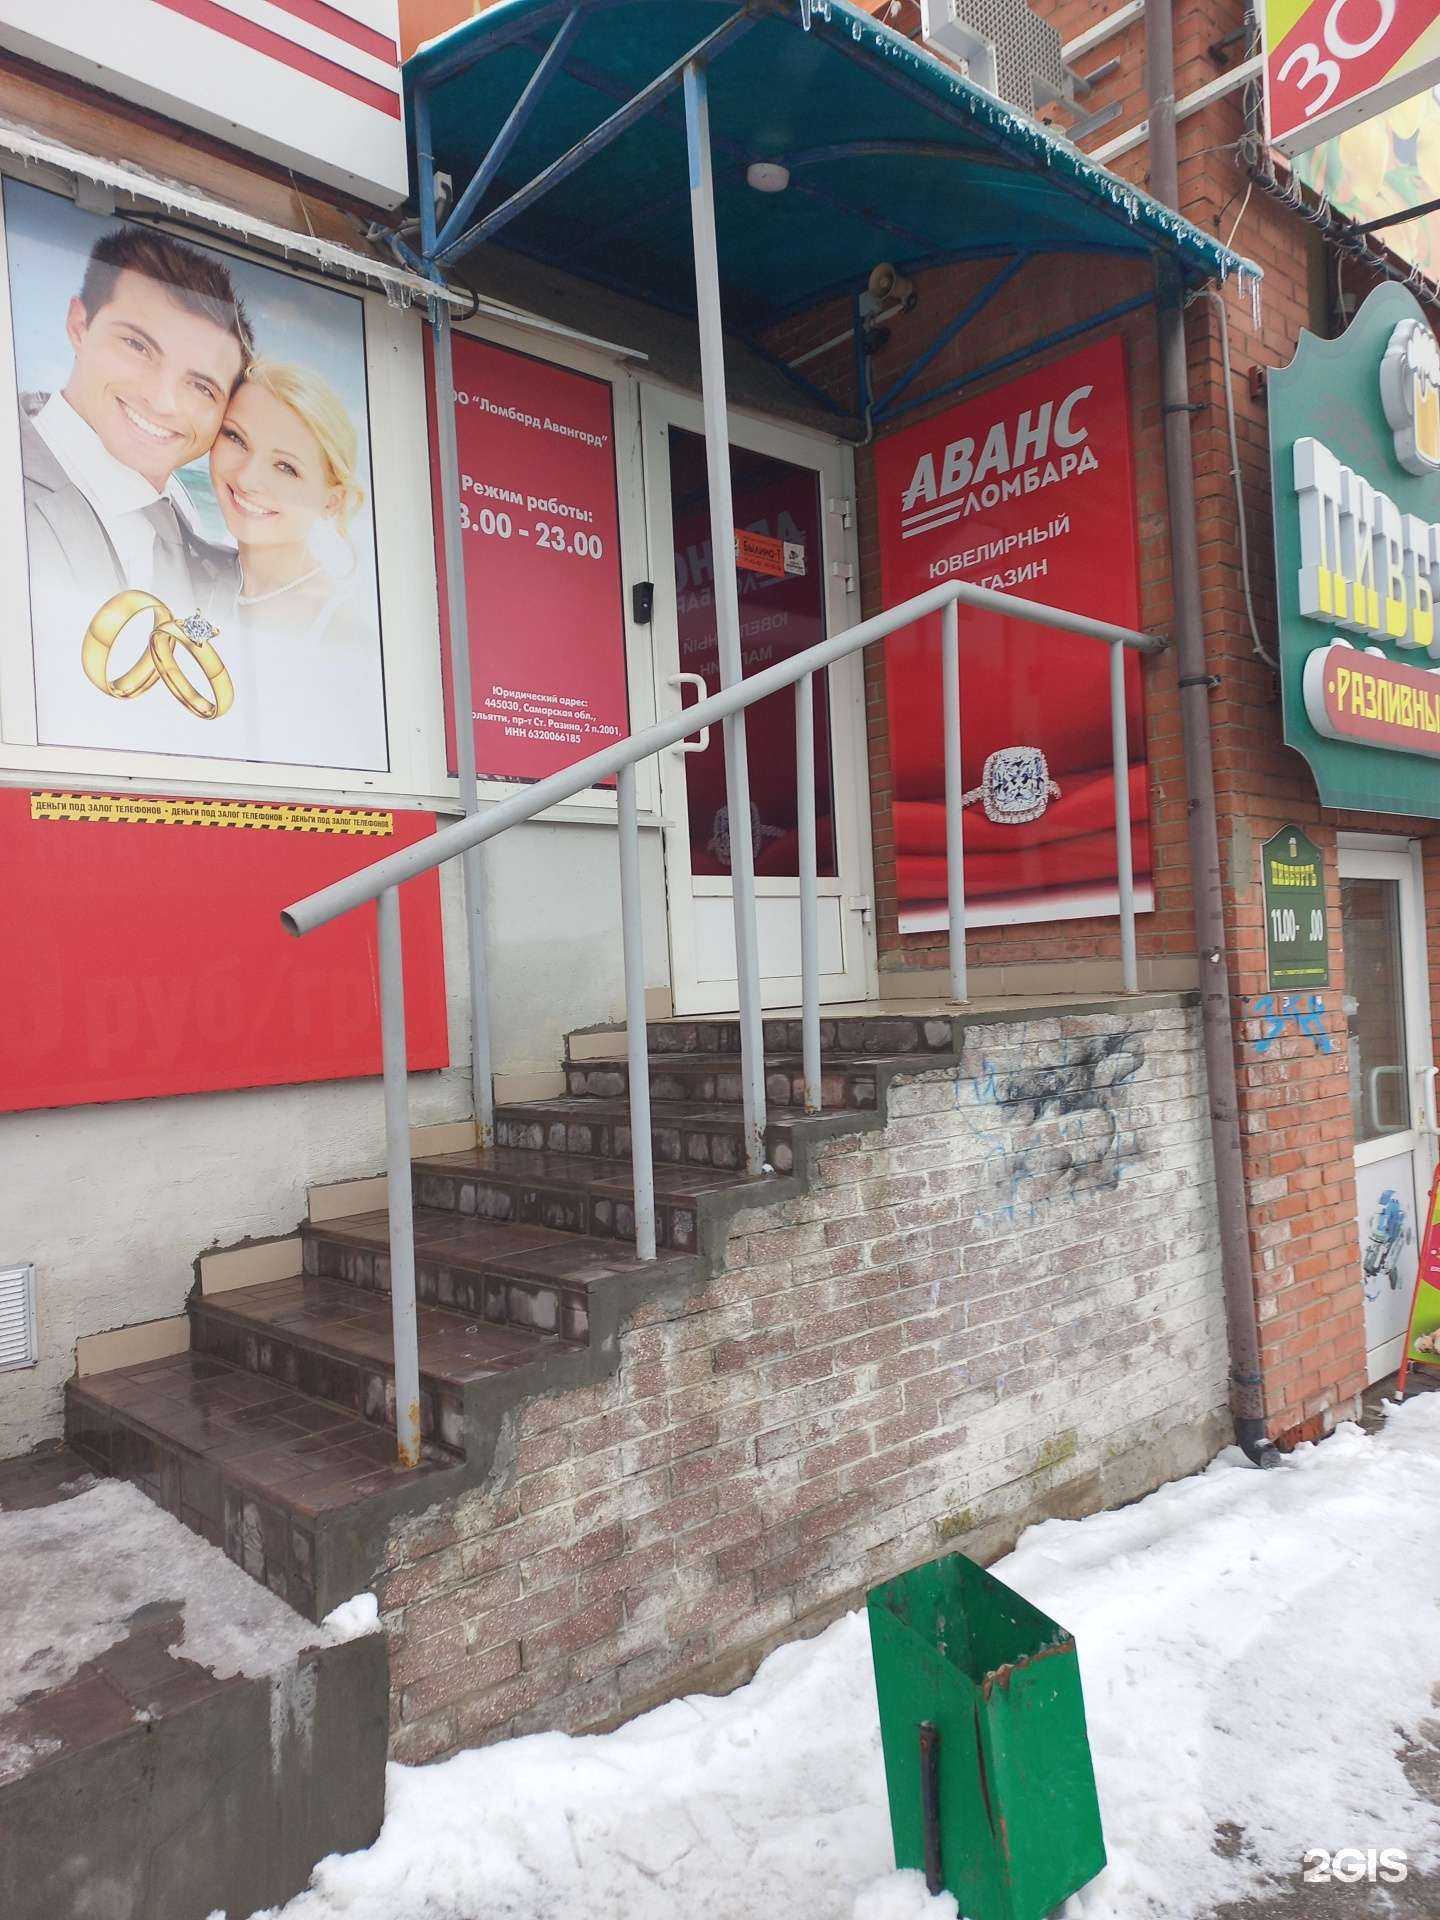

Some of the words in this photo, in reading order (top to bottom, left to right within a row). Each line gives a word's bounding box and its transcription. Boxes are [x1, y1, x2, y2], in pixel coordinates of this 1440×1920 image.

[901, 385, 1094, 512] АВАНС
[963, 445, 1099, 517] ЛОМБАРД
[461, 474, 523, 506] Режим
[527, 495, 593, 523] работы:
[535, 522, 603, 559] 23.00
[929, 512, 1071, 579] ЮВЕЛИРНЫЙ
[1294, 437, 1440, 659] ПИВБ
[971, 559, 1048, 590] ГАЗИН
[484, 698, 521, 712] 445030,
[523, 703, 573, 717] Самарская
[492, 686, 558, 703] Юридический
[559, 697, 588, 707] адрес:
[504, 727, 527, 738] ИНН
[528, 729, 581, 744] 6320066185
[512, 717, 532, 726] пр-т
[533, 717, 546, 727] Ст.
[548, 719, 583, 732] Разина,
[35, 801, 67, 811] ДЕНЬГИ
[69, 803, 86, 812] ПОД
[87, 804, 112, 812] ЗАЛОГ
[116, 805, 162, 815] ТЕЛЕФОНОВ
[171, 807, 199, 816] ДЕНЬГИ
[201, 809, 216, 818] ПОД
[217, 810, 239, 819] ЗАЛОГ
[242, 811, 283, 821] ТЕЛЕФОНОВ
[291, 815, 316, 824] ДЕНЬГИ
[317, 816, 330, 825] ПОД
[332, 817, 352, 826] ЗАЛОГ
[353, 819, 388, 828] ТЕЛЕФОНОВ
